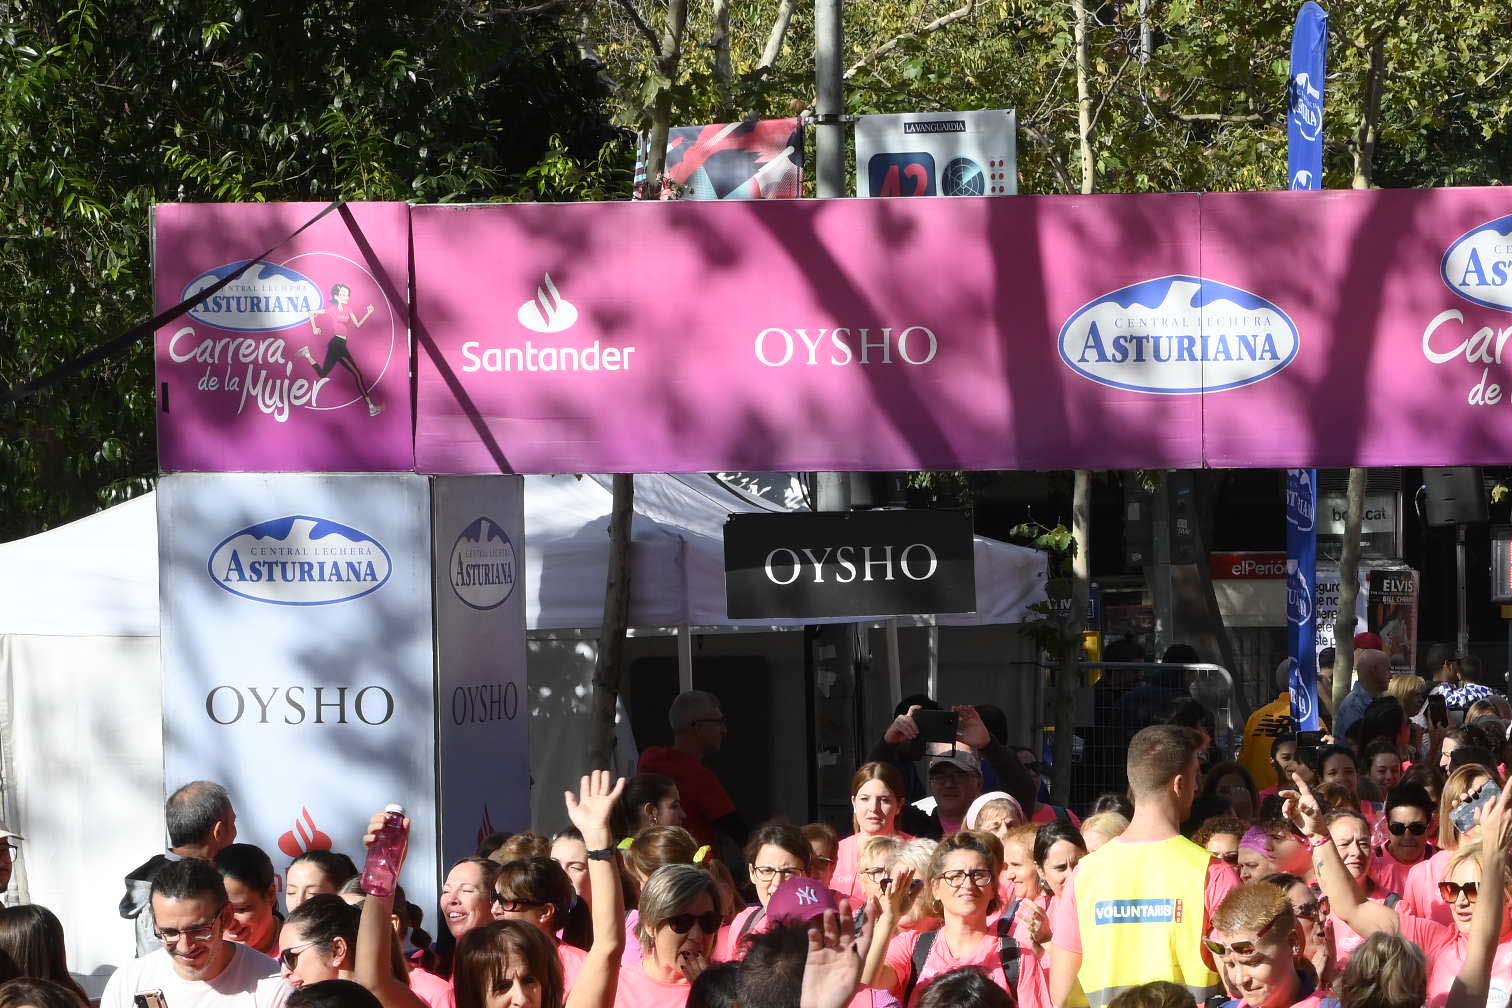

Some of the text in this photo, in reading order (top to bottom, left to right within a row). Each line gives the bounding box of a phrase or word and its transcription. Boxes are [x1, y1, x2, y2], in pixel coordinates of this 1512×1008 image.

[192, 286, 312, 313] ASTURIANA
[1114, 315, 1187, 329] CENTRAL
[169, 327, 286, 364] Carrera
[461, 339, 635, 373] Santander
[754, 325, 938, 367] OYSHO
[1077, 320, 1281, 363] ASTURIANA
[198, 365, 239, 391] de la
[237, 361, 330, 422] Mujer
[1468, 367, 1502, 406] de
[223, 549, 379, 583] ASTURIANA
[250, 546, 372, 556] CENTRAL LECHERA
[455, 551, 513, 587] ASTURIANA
[765, 543, 938, 585] OYSHO
[1232, 560, 1287, 576] elPerió
[1383, 579, 1413, 592] ELVIS
[205, 685, 395, 726] OYSHO
[452, 681, 518, 726] OYSHO
